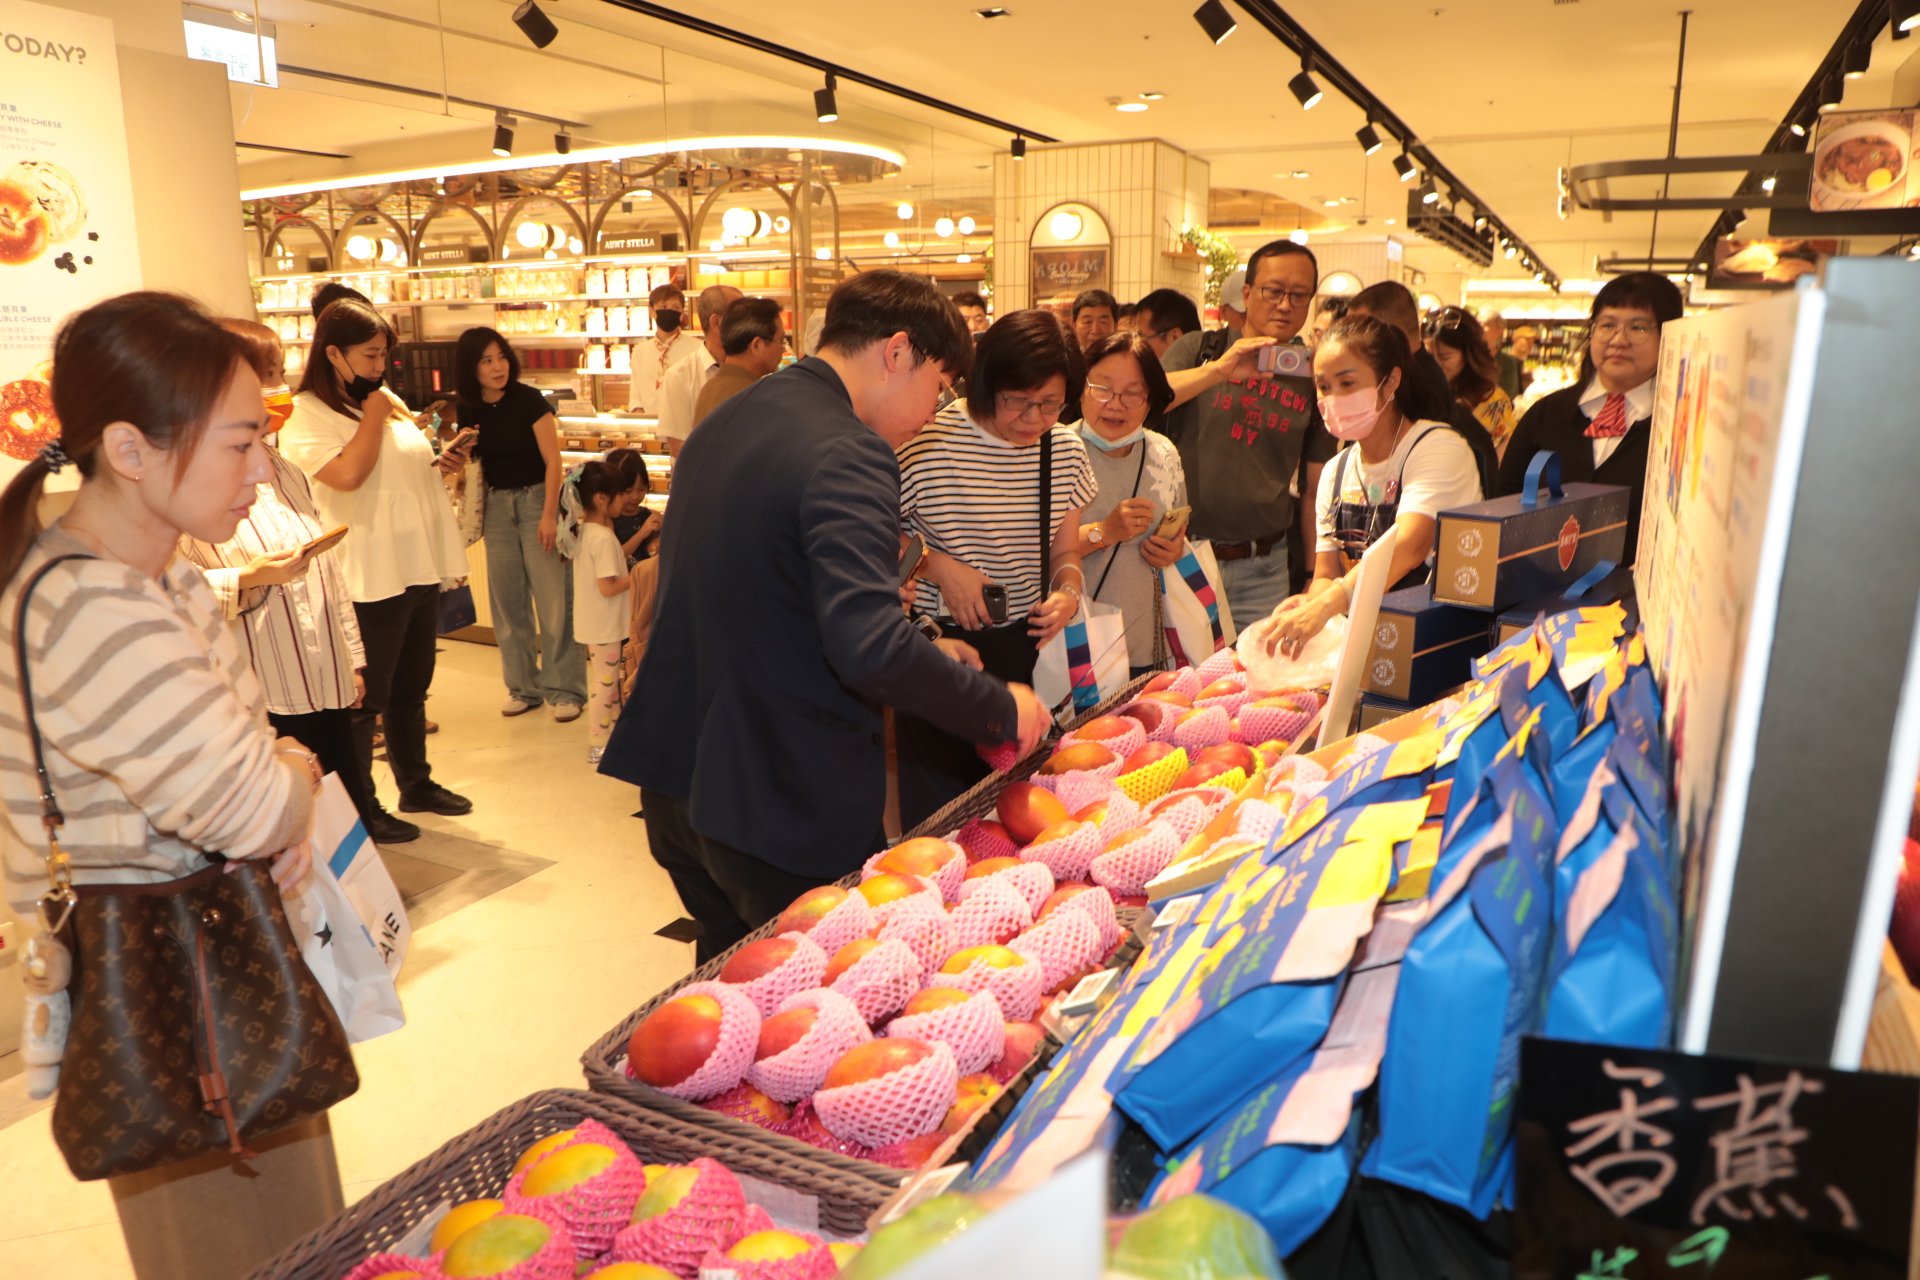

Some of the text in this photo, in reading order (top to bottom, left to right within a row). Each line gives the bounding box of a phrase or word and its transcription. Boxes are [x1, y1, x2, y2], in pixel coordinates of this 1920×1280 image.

[0, 31, 87, 65] ODAY?
[7, 114, 30, 124] WITH
[31, 118, 63, 129] CHEESE
[604, 237, 655, 250] AUNT STELLA
[440, 249, 464, 259] STELLA
[20, 315, 52, 323] CHEESE
[1213, 391, 1233, 411] 18
[1247, 377, 1306, 412] FITCH
[1231, 423, 1258, 446] NY
[1566, 1058, 1862, 1230] 香蕉
